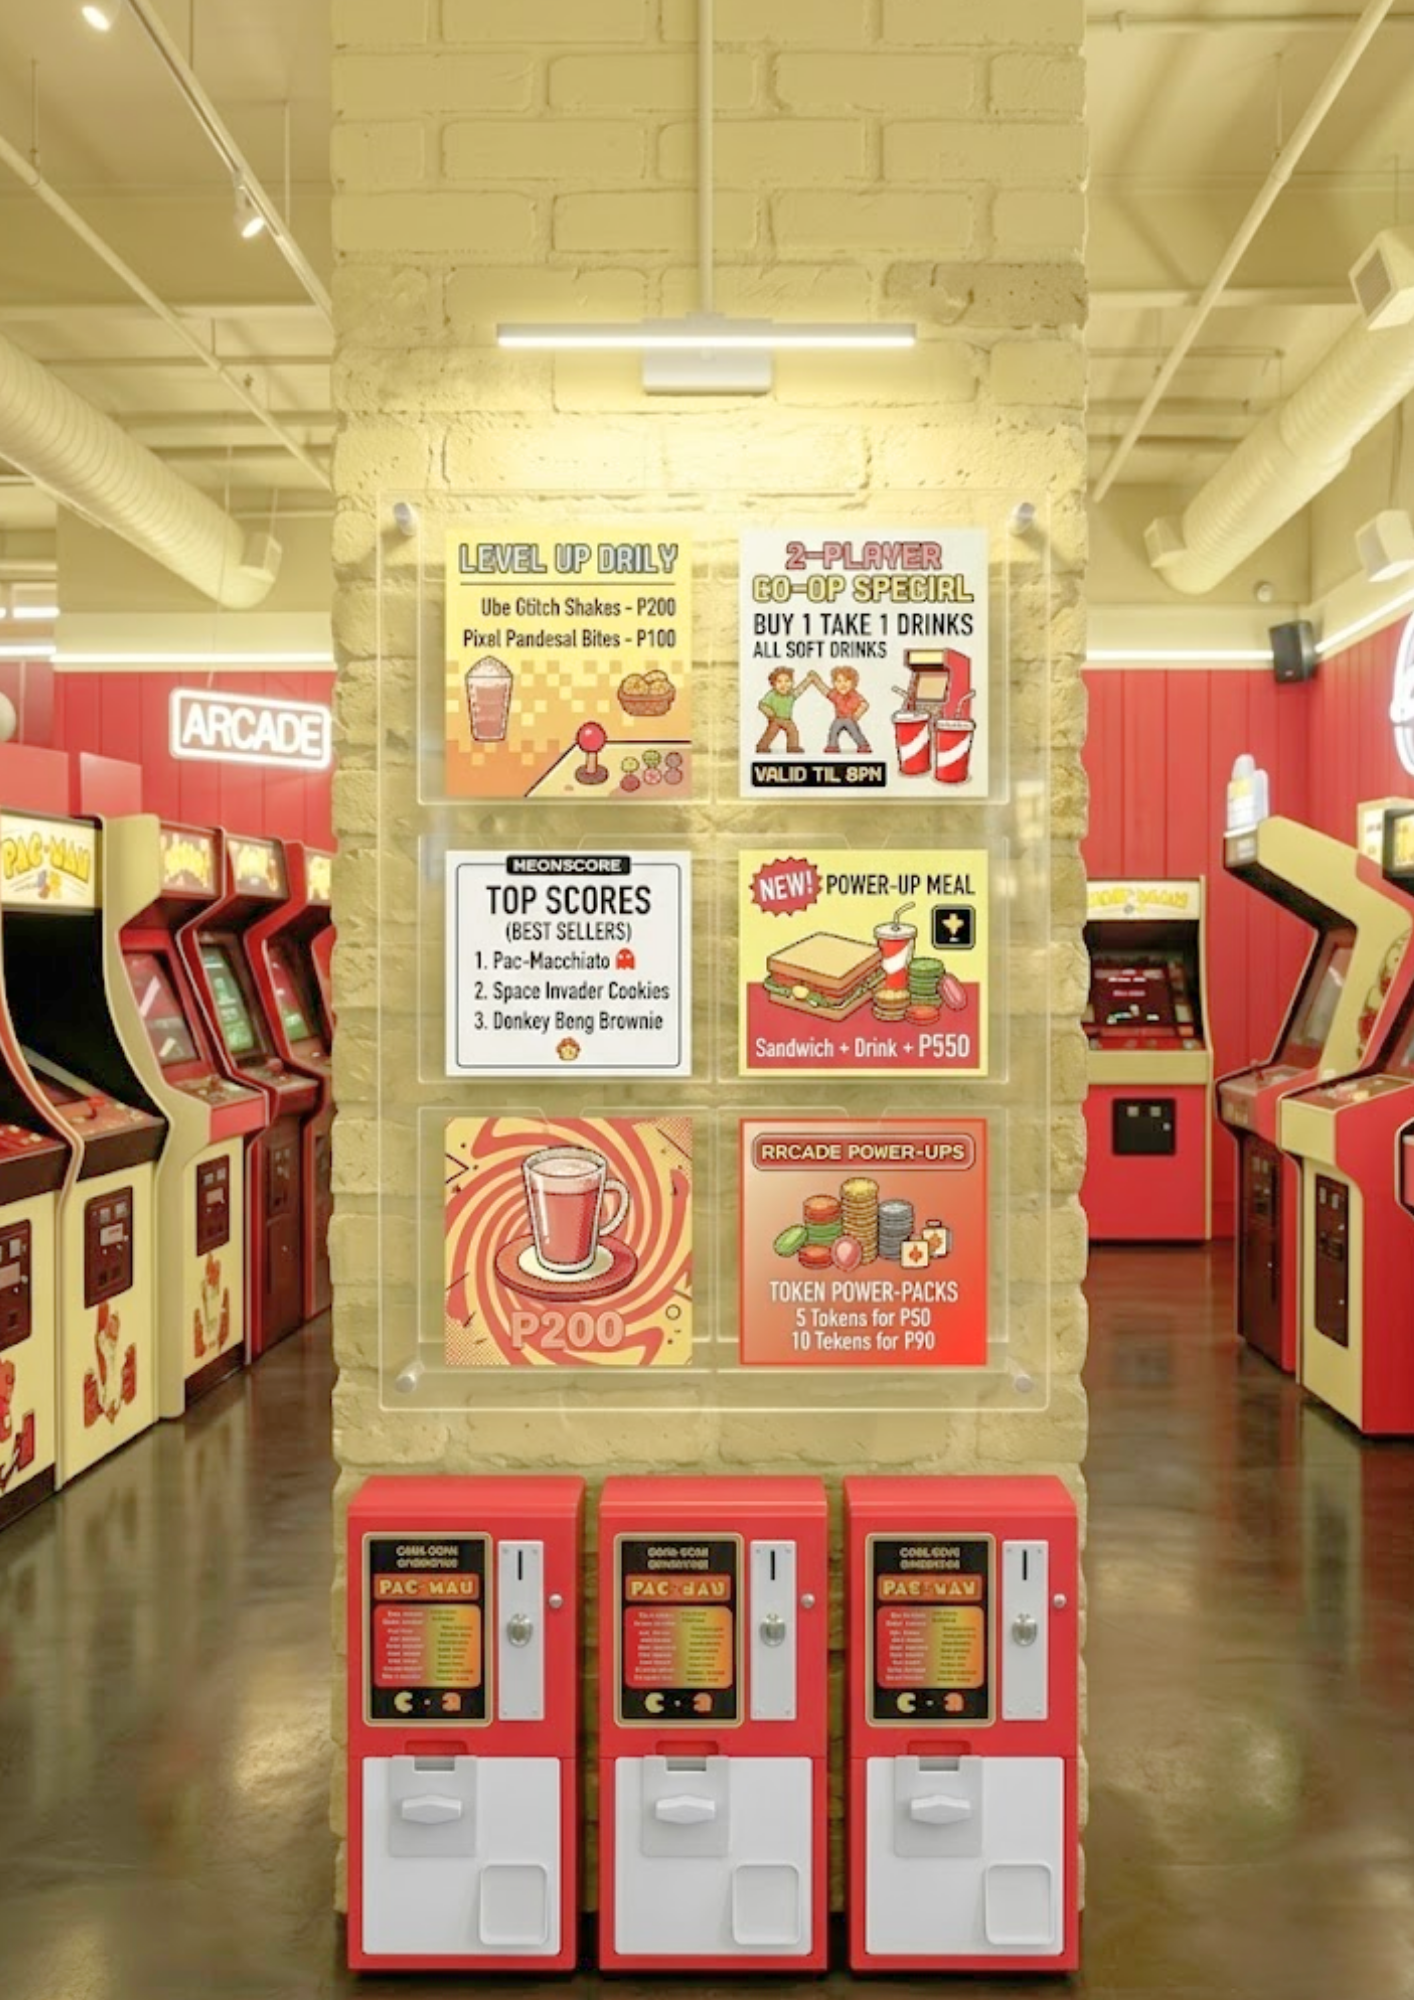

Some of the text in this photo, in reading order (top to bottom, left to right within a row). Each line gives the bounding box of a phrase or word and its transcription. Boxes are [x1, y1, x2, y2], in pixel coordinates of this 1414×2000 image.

[459, 543, 547, 574] LEVEL
[555, 543, 591, 574] UP
[481, 598, 511, 616] Ube
[564, 598, 621, 616] Shakes
[637, 598, 676, 616] P200
[753, 613, 973, 636] BUY 1 TAKE 1 DRINKS
[464, 629, 501, 648] Pixel
[506, 629, 576, 648] Pandesal
[583, 629, 620, 648] Bites
[637, 629, 676, 648] P100
[753, 641, 887, 658] ALL SOFT DRINKS
[182, 702, 323, 756] ARCADE
[754, 766, 807, 783] VALID
[812, 766, 841, 783] TIL
[759, 870, 814, 902] NEW!
[826, 874, 976, 895] POWER-UP MEAL
[486, 885, 652, 915] TOP SCORES
[506, 921, 632, 943] (BEST SELLERS)
[475, 951, 610, 969] 1. Pac-Macchiato
[474, 981, 670, 1004] 2. Space Invader Cookies
[474, 1011, 488, 1030] 3.
[600, 1011, 663, 1030] Brownie
[756, 1033, 970, 1058] Sandwich + Drink + P550
[848, 1144, 965, 1160] POWER-UPS
[769, 1281, 959, 1302] TOKEN POWER-PACKS
[796, 1308, 931, 1327] 5 Tokens for P50
[511, 1311, 626, 1349] P200
[792, 1331, 811, 1350] 10
[876, 1331, 899, 1350] for
[904, 1331, 935, 1350] P90
